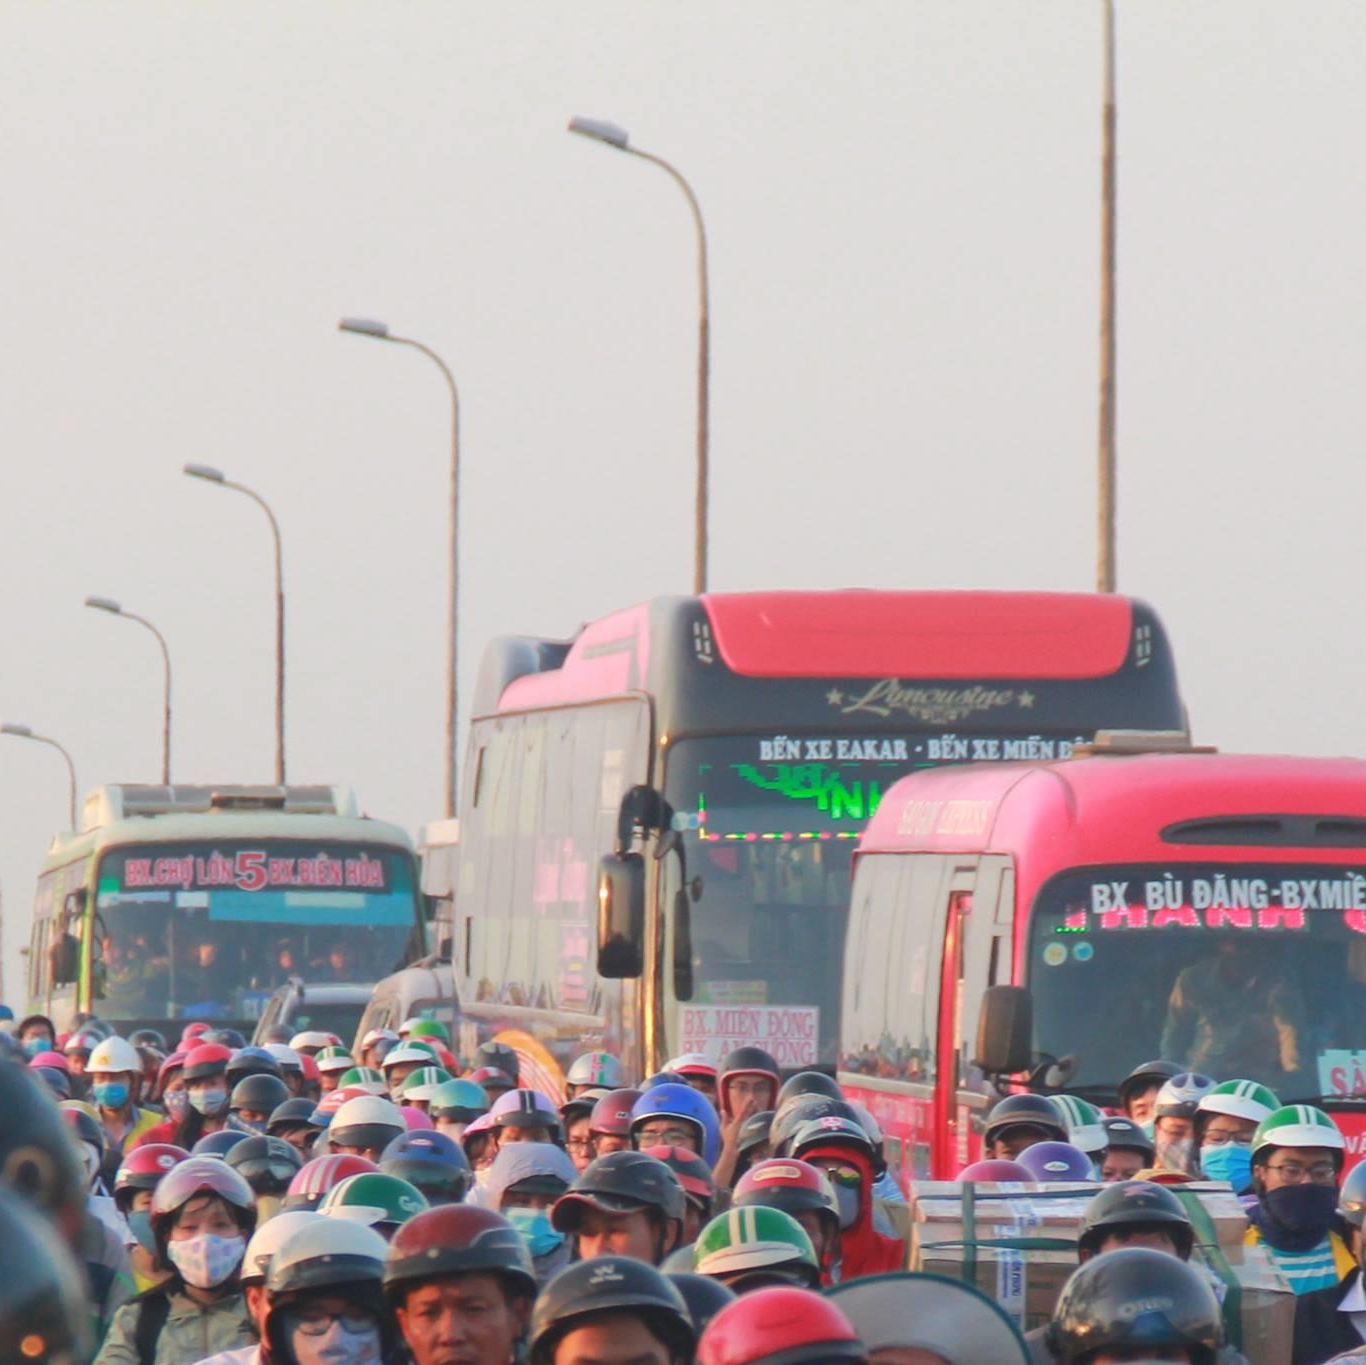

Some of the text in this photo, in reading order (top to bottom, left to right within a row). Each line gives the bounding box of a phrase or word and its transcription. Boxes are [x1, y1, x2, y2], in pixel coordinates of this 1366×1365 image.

[842, 678, 1013, 717] Limousine
[760, 735, 801, 760] BẾN
[805, 740, 833, 760] XE
[837, 739, 908, 760] EAKAR
[928, 734, 968, 760] BẾN
[972, 740, 1000, 760] XE
[235, 850, 268, 891] 5
[1091, 882, 1129, 914] BX
[1146, 872, 1184, 911] BÙ
